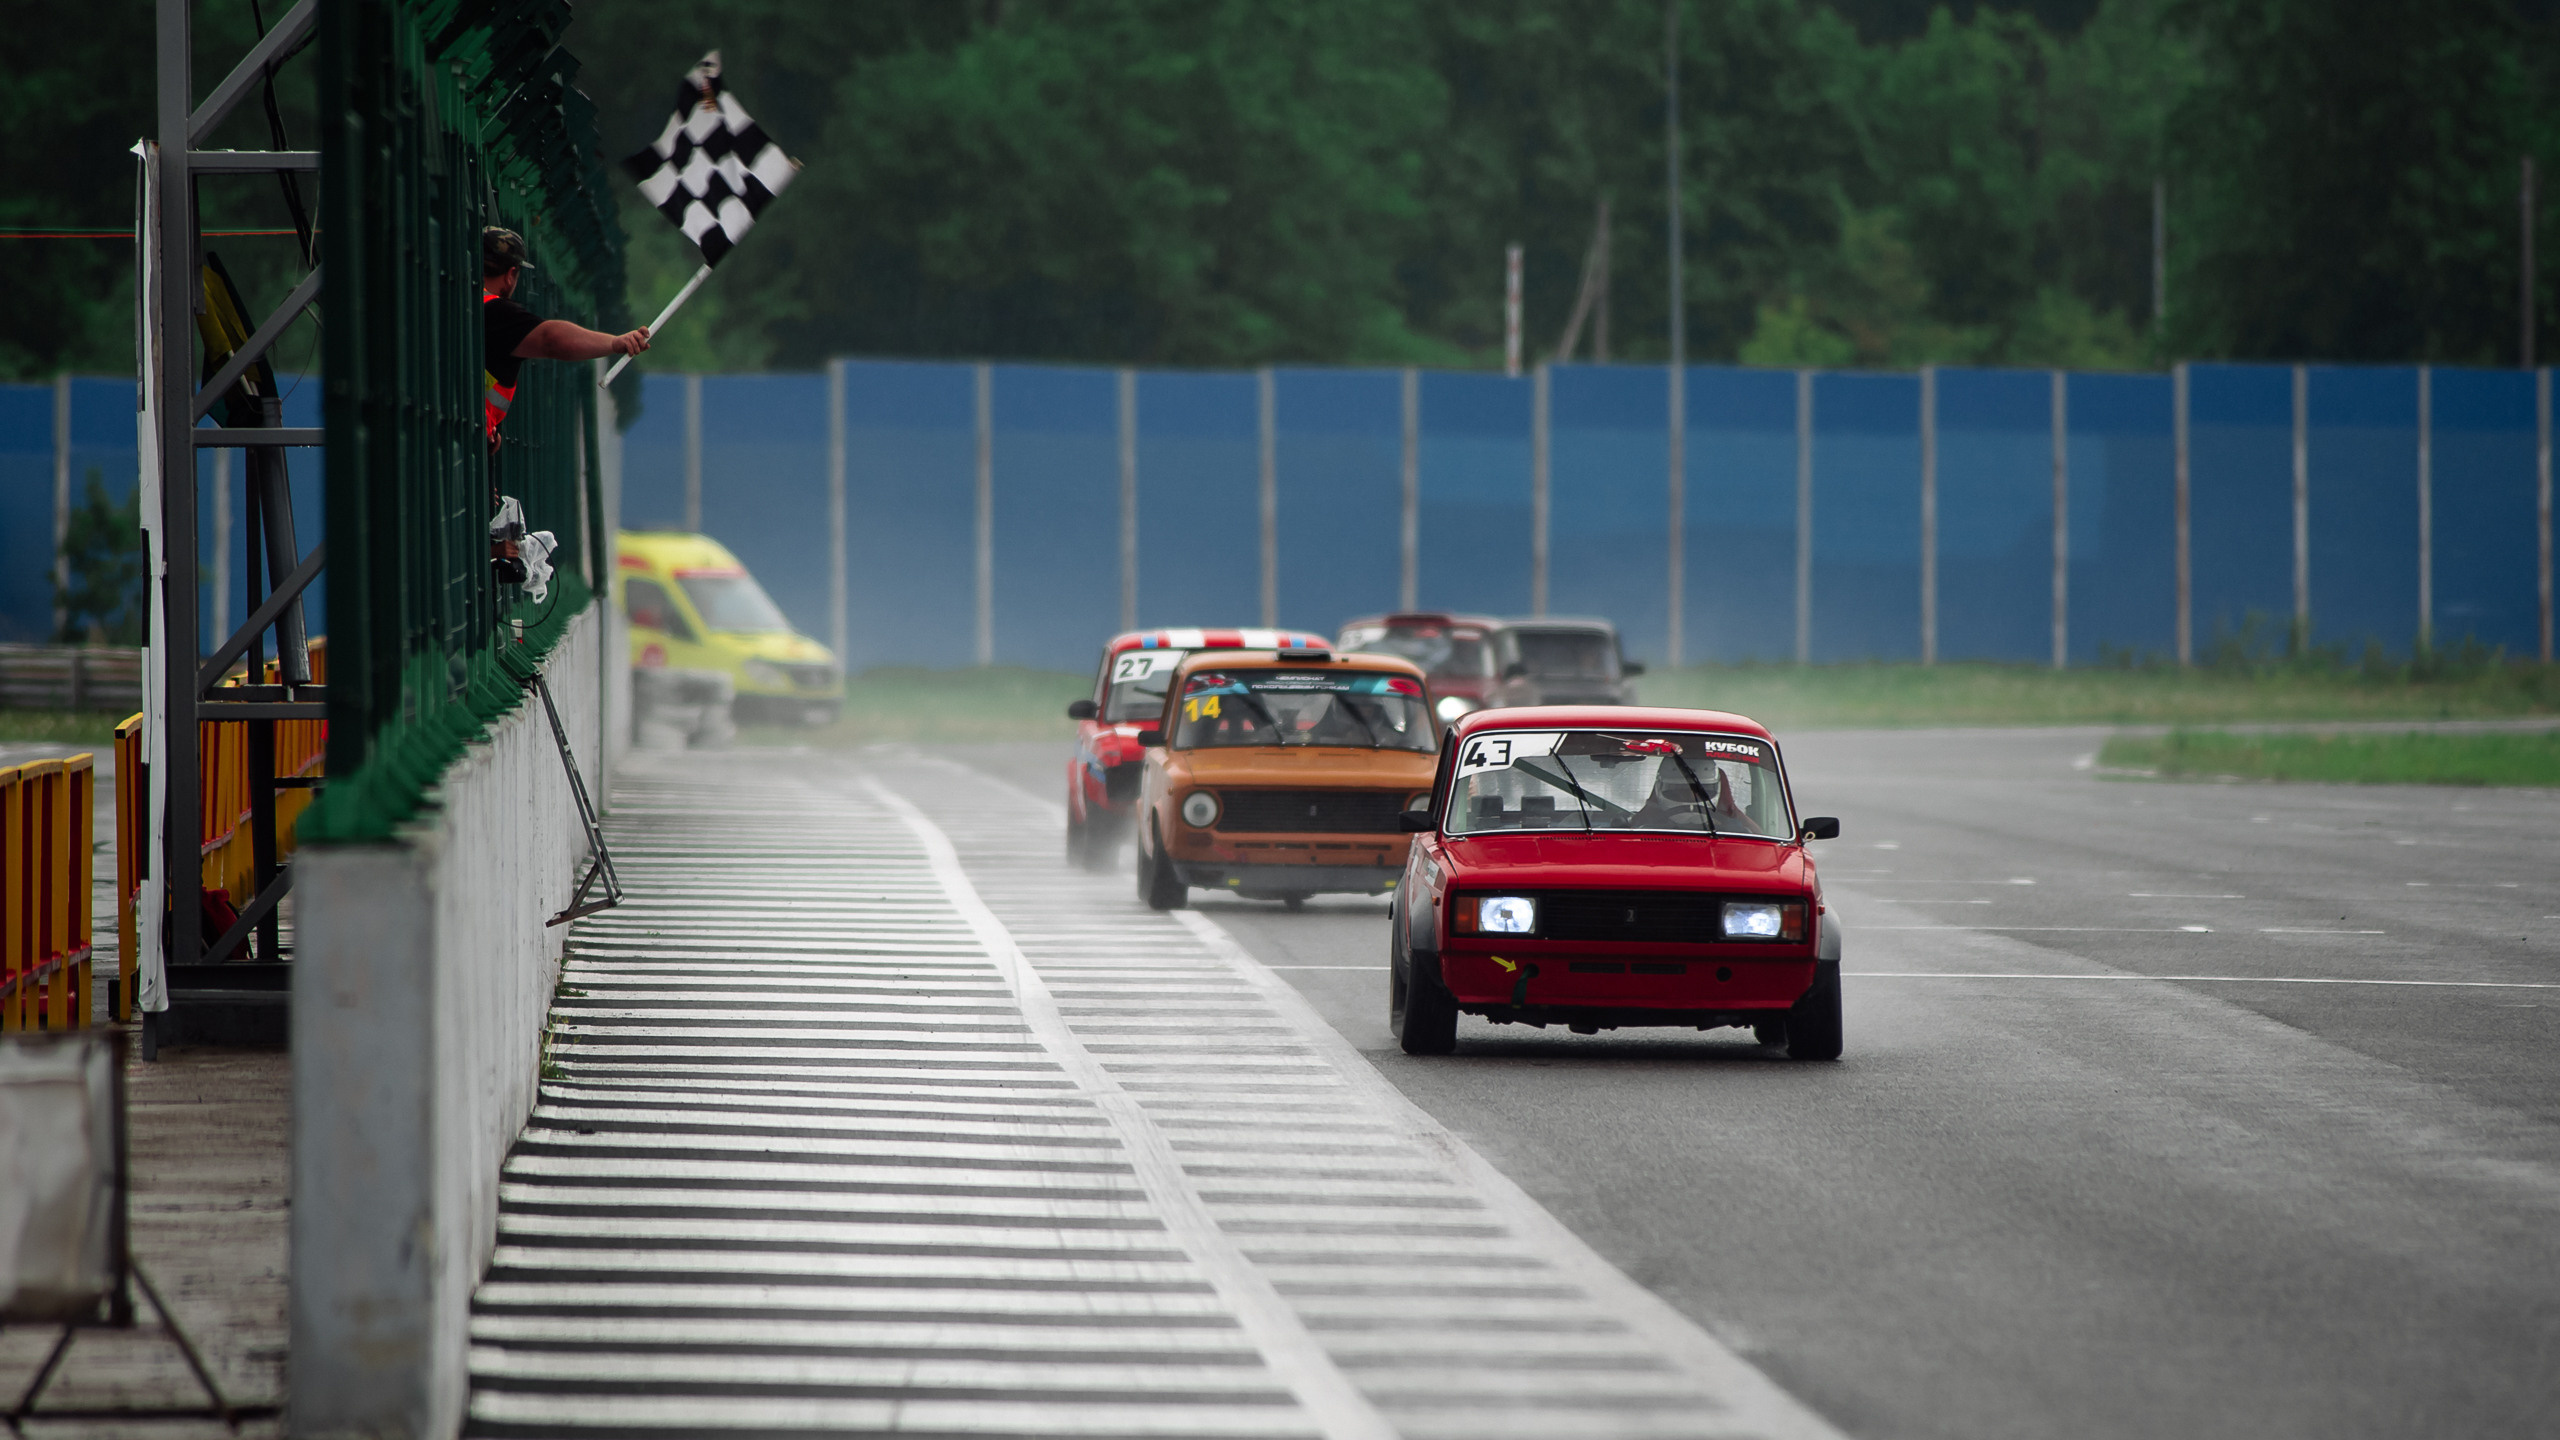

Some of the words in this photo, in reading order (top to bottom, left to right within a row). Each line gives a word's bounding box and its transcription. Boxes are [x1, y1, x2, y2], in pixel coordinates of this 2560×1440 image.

[1118, 657, 1154, 679] 27
[1185, 695, 1222, 722] 14
[1463, 739, 1512, 768] 43
[1704, 741, 1760, 757] КУБОК
